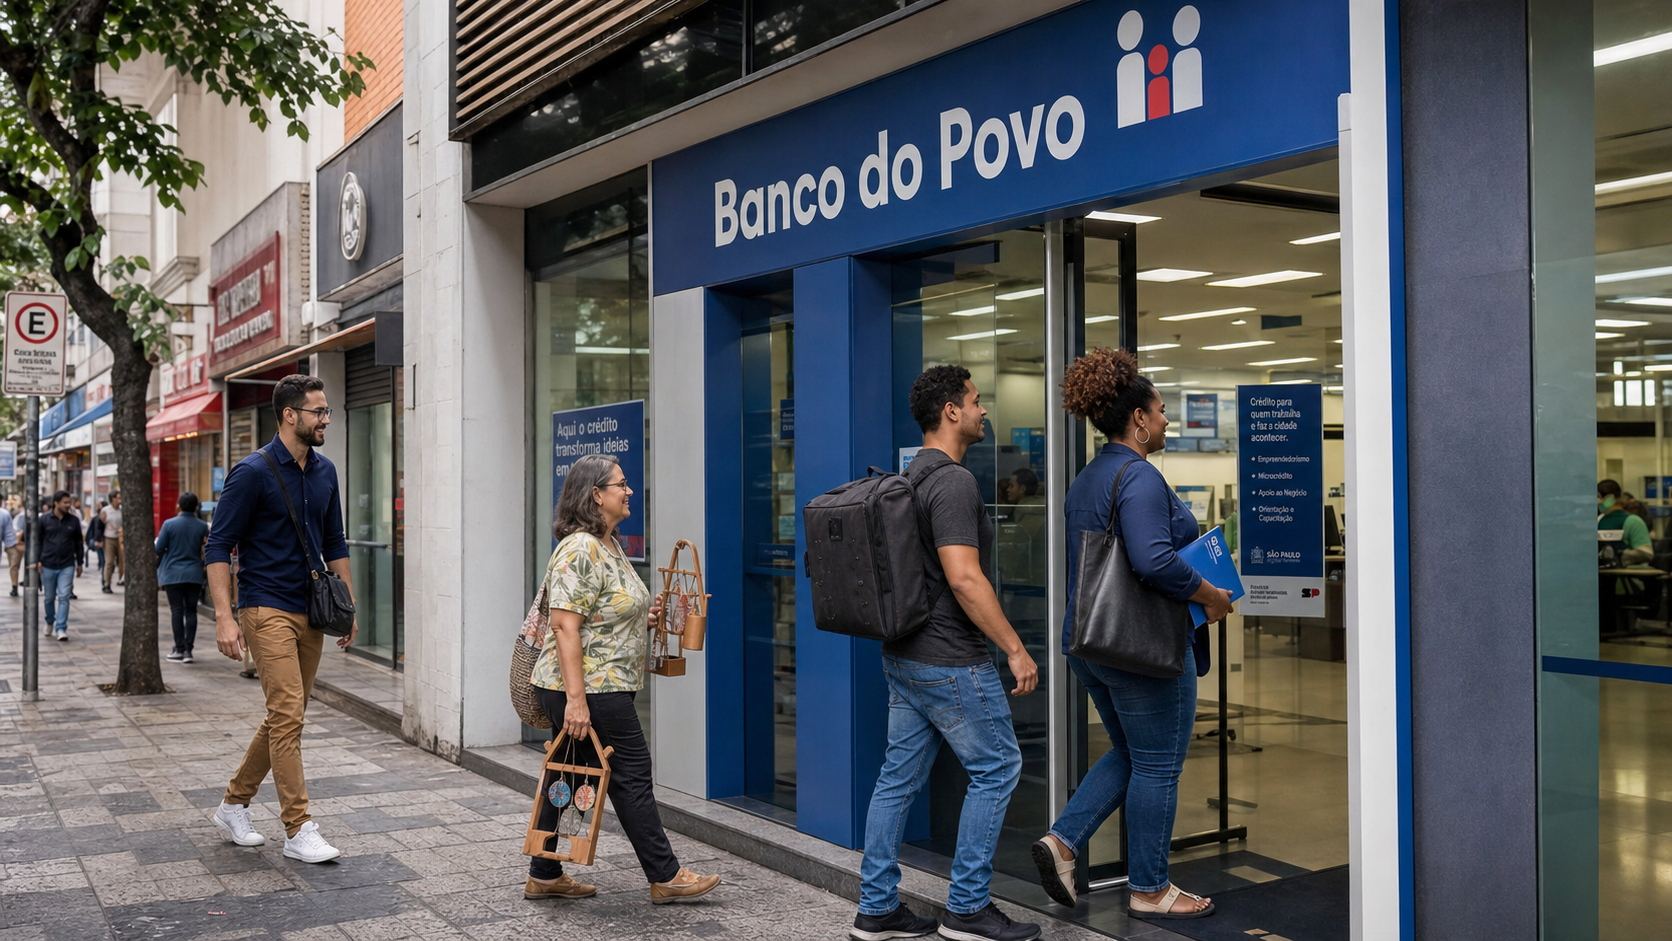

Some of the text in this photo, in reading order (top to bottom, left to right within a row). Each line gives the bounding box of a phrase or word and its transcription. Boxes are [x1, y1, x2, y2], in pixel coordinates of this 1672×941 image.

[714, 94, 1085, 248] Banco do Povo
[29, 312, 45, 334] E
[1250, 398, 1292, 408] Crédito para
[1250, 409, 1301, 419] quem trabalha
[557, 417, 618, 440] Aqui o crédito
[1257, 421, 1268, 430] faz
[1274, 421, 1298, 430] cidade
[1250, 434, 1288, 442] acontecer.
[556, 437, 628, 456] transforma ideias
[556, 464, 570, 477] em
